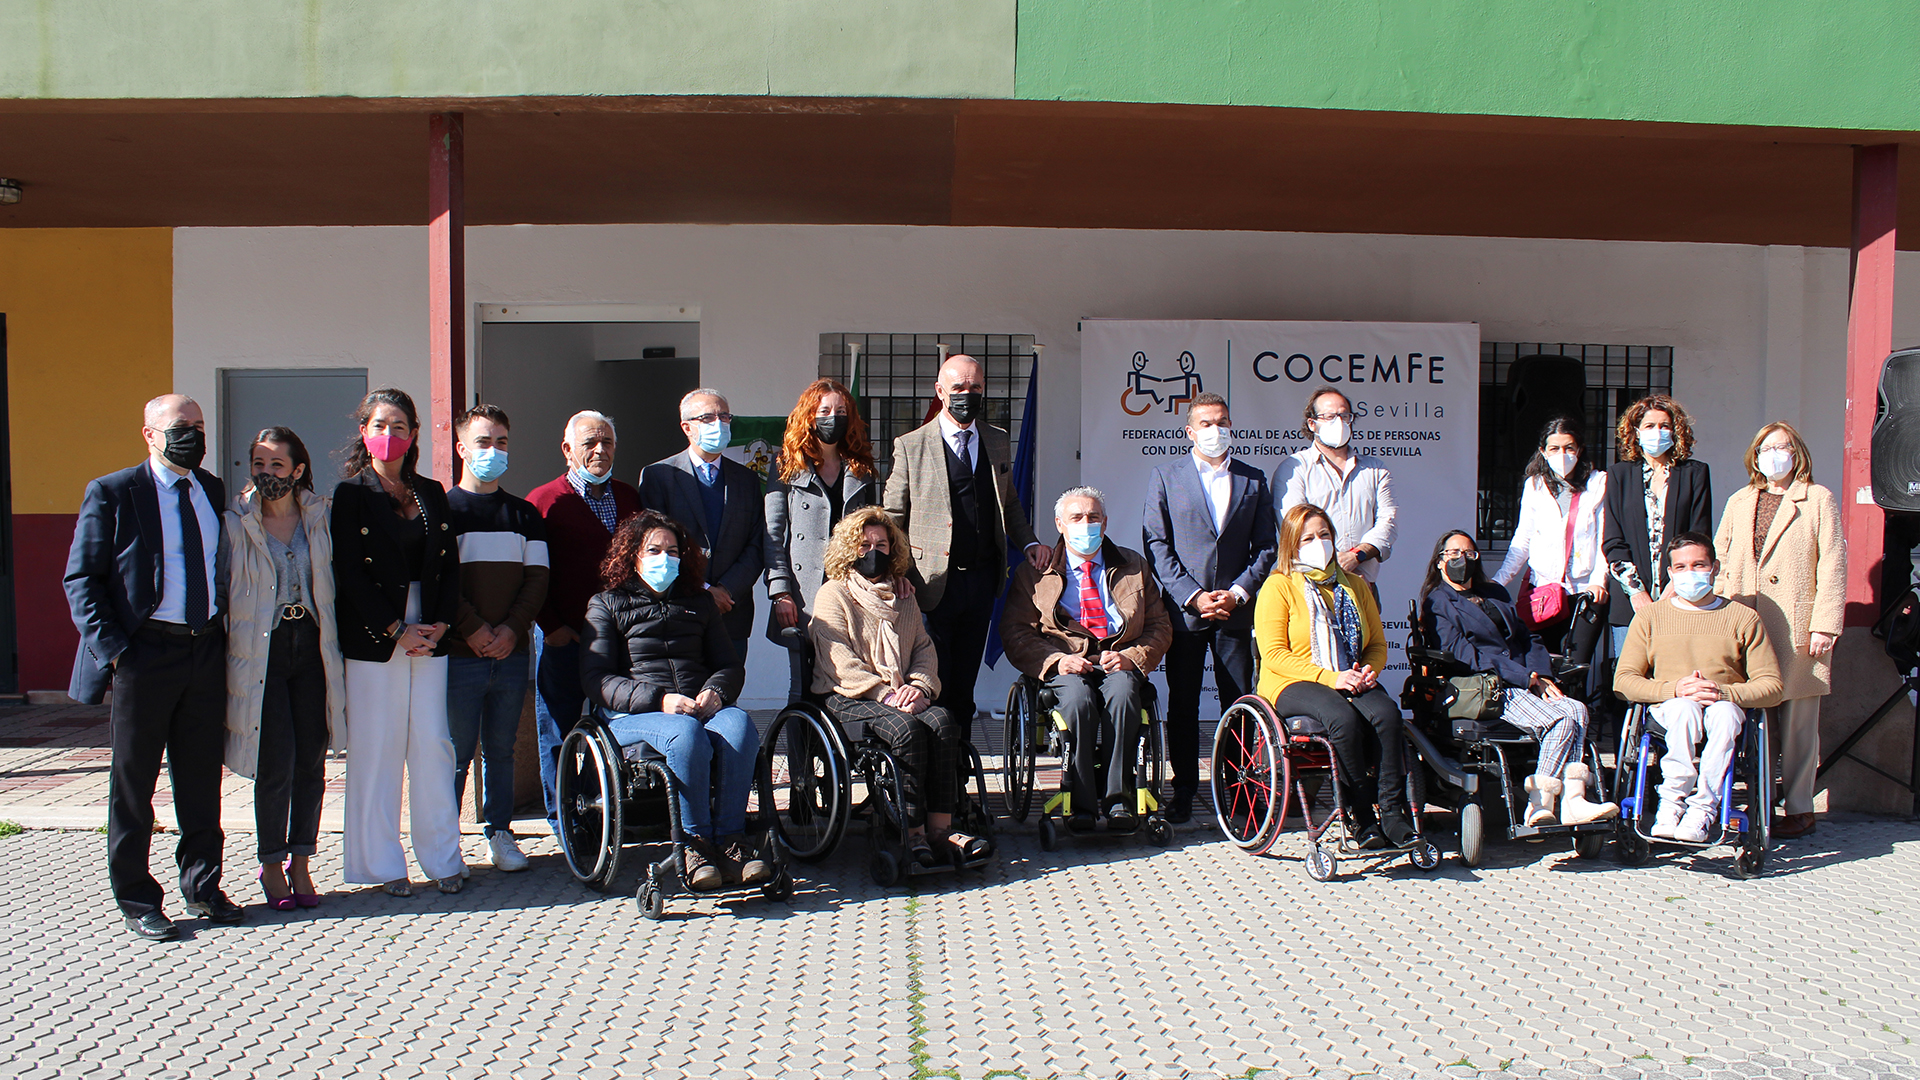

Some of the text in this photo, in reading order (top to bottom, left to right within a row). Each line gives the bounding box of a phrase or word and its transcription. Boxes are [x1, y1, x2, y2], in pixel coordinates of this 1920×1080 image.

[1252, 351, 1445, 384] COCEMFE
[1356, 401, 1445, 418] Sevilla
[1122, 427, 1188, 439] FEDERACIÓ
[1265, 430, 1280, 439] DE
[1367, 431, 1382, 440] DE
[1384, 431, 1441, 441] PERSONAS
[1142, 446, 1166, 455] CON
[1254, 443, 1288, 456] FÍSICA
[1363, 446, 1377, 456] DE
[1380, 446, 1422, 457] SEVILLA
